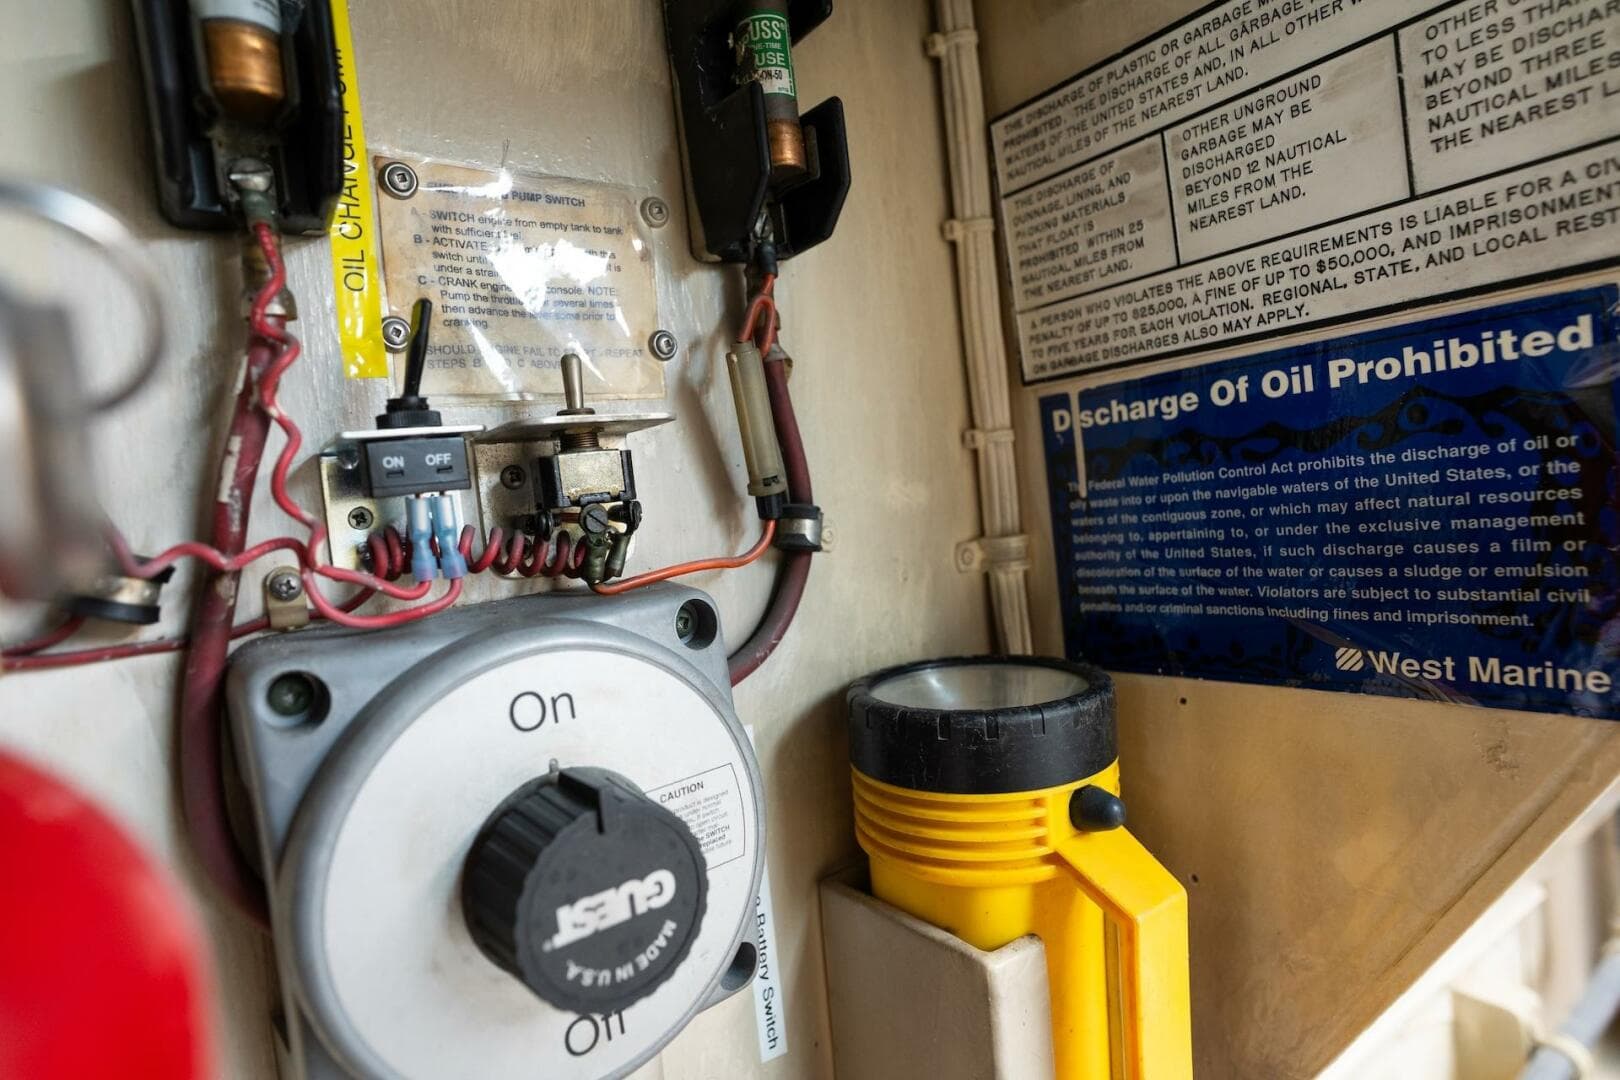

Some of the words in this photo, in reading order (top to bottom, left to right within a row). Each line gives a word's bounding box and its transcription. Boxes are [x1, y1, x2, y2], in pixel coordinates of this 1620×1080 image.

[1161, 39, 1180, 56] OR
[1184, 1, 1252, 45] GARBAGE
[1174, 52, 1192, 69] OF
[1197, 36, 1226, 58] ALL
[1230, 0, 1304, 42] GARBAGE
[1230, 47, 1245, 62] IN
[1250, 30, 1280, 54] ALL
[1285, 1, 1344, 36] OTHER
[1422, 44, 1448, 66] TO
[1456, 16, 1516, 53] LESS
[1425, 0, 1498, 41] OTHER
[1424, 59, 1466, 89] MAY
[1474, 45, 1504, 70] BE
[1426, 66, 1513, 110] BEYOND
[1520, 30, 1606, 74] THREE
[1141, 84, 1202, 122] NEAREST
[1207, 66, 1249, 93] LAND.
[1182, 114, 1230, 142] OTHER
[1234, 74, 1322, 120] UNGROUND
[1428, 84, 1538, 134] NAUTICAL
[1181, 126, 1248, 161] GARBAGE
[1252, 110, 1284, 134] MAY
[1290, 99, 1313, 119] BE
[1430, 128, 1472, 154] THE
[1480, 86, 1594, 138] NEAREST
[1182, 134, 1276, 180] DISCHARGED
[1185, 167, 1242, 196] BEYOND
[1246, 160, 1261, 174] 12
[1265, 129, 1348, 169] NAUTICAL
[512, 190, 542, 202] PUMP
[544, 194, 586, 208] SWITCH
[1188, 190, 1230, 215] MILES
[1234, 174, 1276, 200] FROM
[1280, 160, 1314, 182] THE
[430, 210, 474, 222] SWITCH
[514, 219, 538, 230] from
[540, 221, 568, 234] empty
[570, 224, 590, 234] tank
[592, 226, 602, 234] to
[603, 226, 624, 236] tank
[432, 224, 452, 234] with
[1190, 200, 1255, 232] NEAREST
[1260, 185, 1306, 210] LAND.
[432, 236, 488, 251] ACTIVATE
[1176, 274, 1204, 292] THE
[1208, 258, 1257, 284] ABOVE
[1261, 222, 1393, 269] REQUIREMENTS
[1400, 214, 1418, 232] IS
[1424, 192, 1498, 226] LIABLE
[1505, 177, 1553, 203] FOR
[1426, 246, 1465, 269] AND
[1473, 228, 1548, 257] LOCAL
[342, 250, 365, 293] OIL
[432, 250, 463, 262] switch
[434, 264, 462, 274] under
[1205, 282, 1237, 305] FINE
[1242, 277, 1260, 293] OF
[1265, 270, 1286, 287] UP
[1289, 264, 1311, 280] TO
[1402, 231, 1442, 252] AND
[438, 276, 478, 288] CRANK
[440, 290, 471, 302] Pump
[473, 293, 489, 302] the
[589, 300, 614, 308] times
[442, 304, 466, 314] then
[468, 306, 510, 317] advance
[606, 312, 616, 321] to
[1184, 326, 1218, 344] ALSO
[1223, 316, 1252, 334] MAY
[1256, 304, 1310, 328] APPLY.
[1052, 392, 1199, 432] Dscharge
[1210, 376, 1249, 407] Of
[1261, 364, 1314, 398] Oil
[1328, 314, 1594, 388] Prohibited
[382, 456, 404, 468] ON
[425, 453, 452, 466] OFF
[1218, 463, 1266, 479] Control
[1270, 462, 1294, 474] Act
[1298, 454, 1366, 474] prohibits
[1370, 452, 1396, 465] the
[1402, 442, 1490, 462] discharge
[1497, 439, 1517, 454] of
[1523, 435, 1548, 450] oil
[1555, 436, 1580, 448] or
[1216, 484, 1278, 500] navigable
[1282, 482, 1330, 494] waters
[1334, 478, 1350, 490] of
[1355, 476, 1380, 489] the
[1386, 470, 1440, 487] United
[1446, 467, 1512, 482] States,
[1518, 465, 1540, 477] or
[1546, 460, 1582, 474] the
[1250, 506, 1264, 518] or
[1269, 502, 1312, 516] which
[1318, 502, 1348, 514] may
[1354, 497, 1401, 512] affect
[1408, 492, 1470, 508] natural
[1478, 488, 1584, 504] resources
[1254, 526, 1269, 536] or
[1276, 524, 1319, 536] under
[1326, 522, 1351, 534] the
[1358, 518, 1441, 533] exclusive
[1451, 512, 1586, 532] management
[1263, 544, 1272, 556] if
[1280, 545, 1315, 557] such
[1323, 543, 1404, 558] discharge
[1413, 541, 1480, 554] causes
[1490, 541, 1501, 553] a
[1511, 538, 1552, 552] film
[1563, 539, 1587, 552] or
[1242, 566, 1264, 577] the
[1268, 566, 1304, 577] water
[1309, 566, 1324, 578] or
[1329, 566, 1384, 578] causes
[1389, 566, 1398, 577] a
[1404, 564, 1462, 580] sludge
[1468, 565, 1488, 578] or
[1494, 563, 1588, 578] emulsion
[1256, 586, 1320, 598] Violators
[1324, 588, 1346, 599] are
[1352, 588, 1410, 602] subject
[1414, 588, 1431, 601] to
[1437, 588, 1540, 602] substantial
[1266, 605, 1330, 622] including
[1333, 608, 1370, 621] fines
[1373, 610, 1402, 622] and
[1407, 610, 1534, 627] imprisonment.
[1368, 650, 1456, 681] West
[1468, 656, 1612, 694] Marine
[509, 691, 576, 732] On
[660, 781, 704, 804] CAUTION
[706, 824, 730, 840] SWITCH
[551, 868, 676, 951] GUEST
[638, 920, 678, 972] MADE
[616, 964, 636, 982] IN
[763, 986, 778, 1050] Switch
